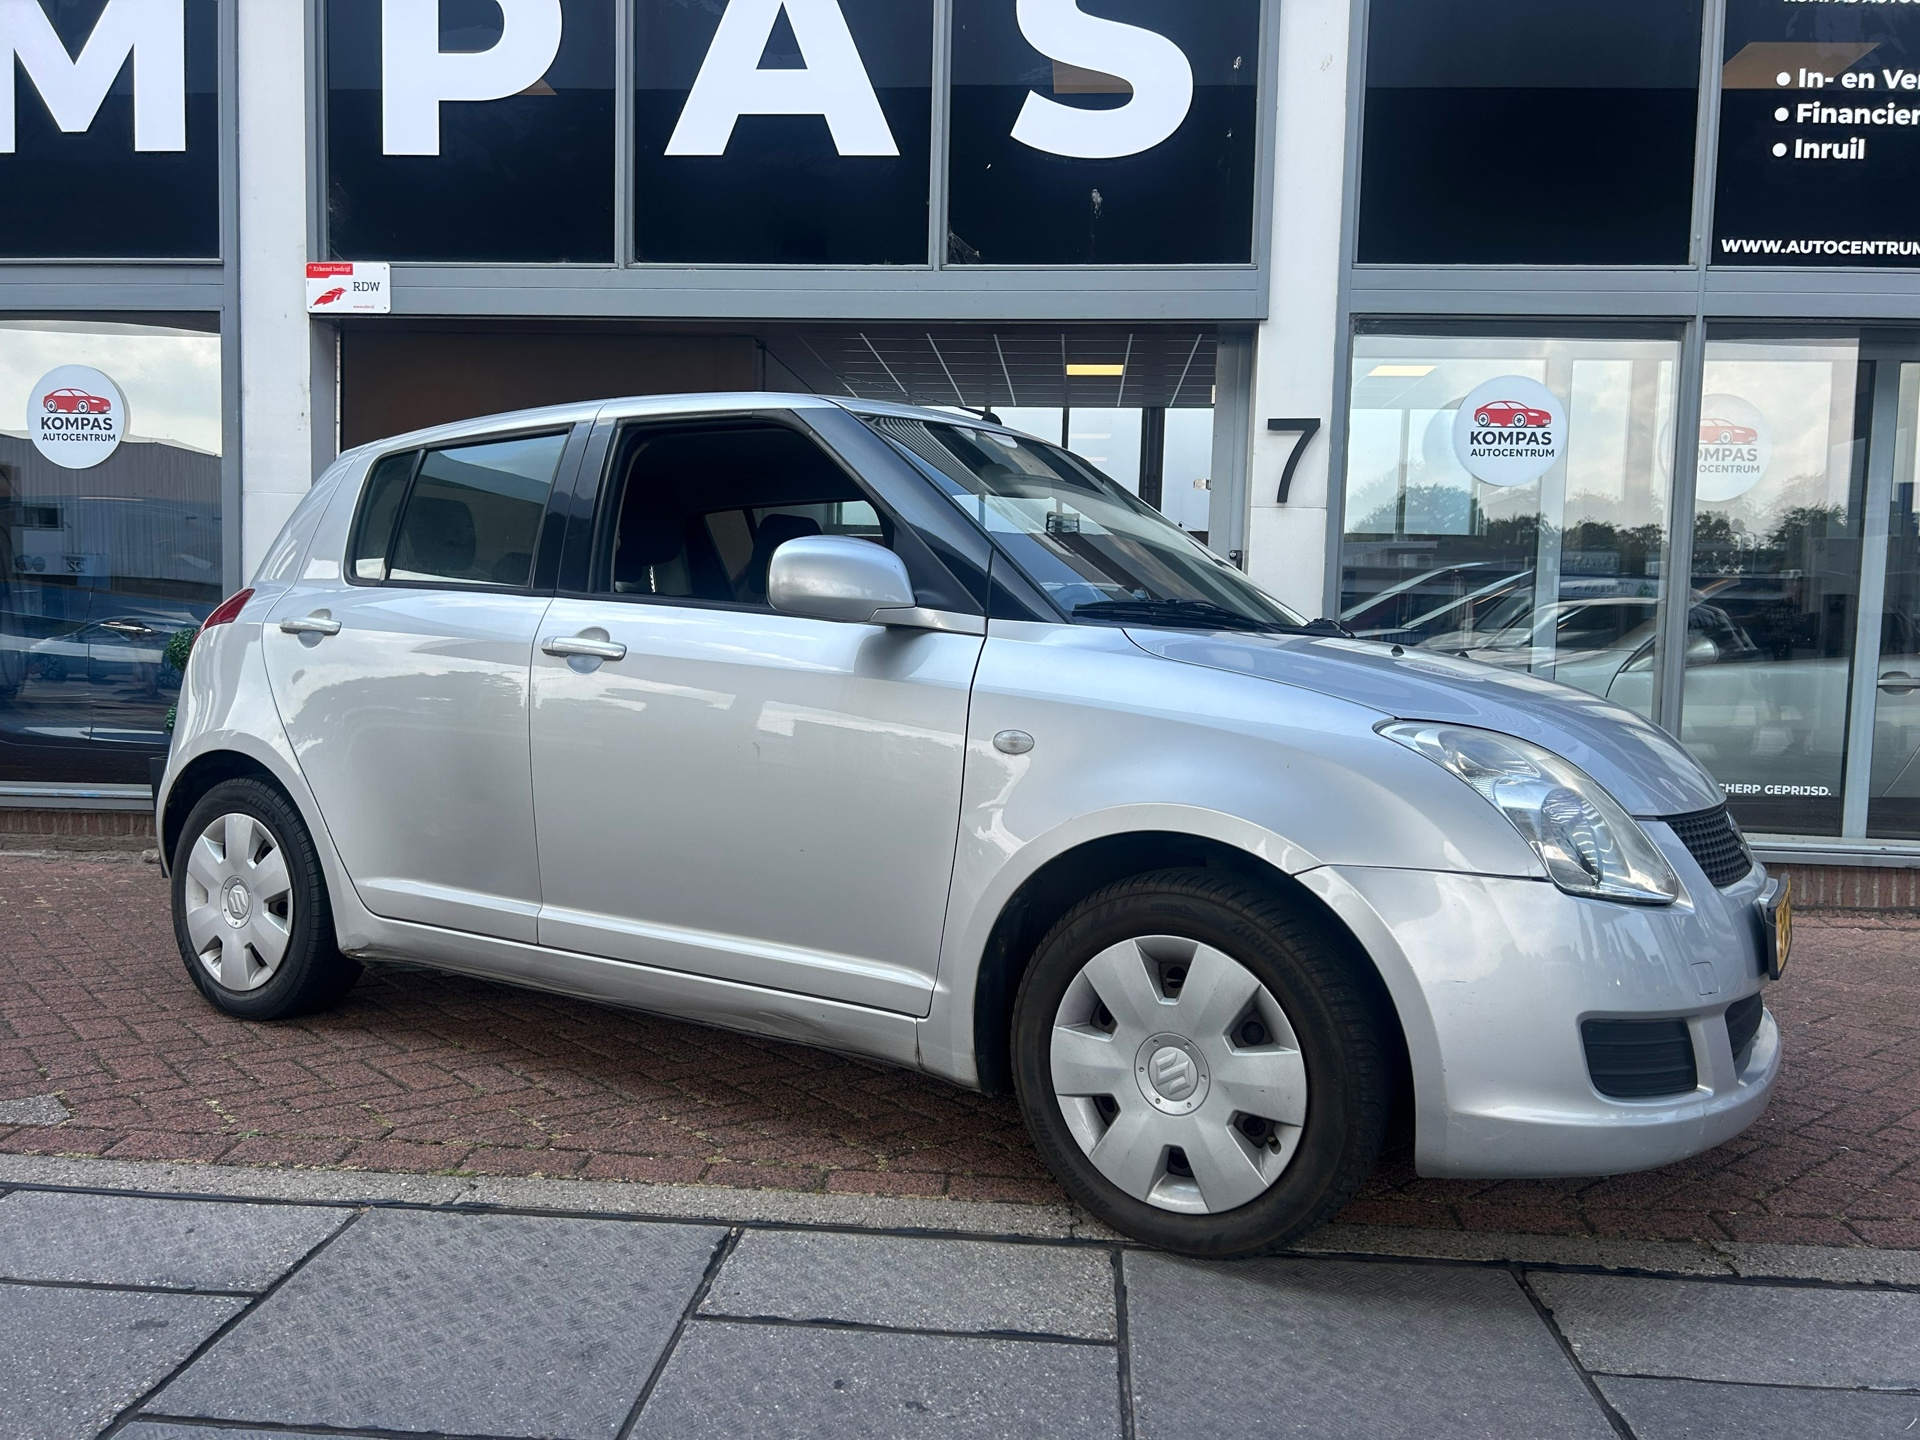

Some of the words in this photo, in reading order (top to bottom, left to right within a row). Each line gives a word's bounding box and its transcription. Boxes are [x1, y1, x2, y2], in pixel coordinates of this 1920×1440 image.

[1798, 68, 1834, 88] In-
[1841, 72, 1875, 89] en
[1882, 69, 1920, 90] Ve
[1794, 137, 1866, 160] Inruil
[352, 281, 381, 292] RDW
[40, 416, 113, 430] KOMPAS
[42, 433, 116, 442] AUTOCENTRUM
[1469, 431, 1552, 446] KOMPAS
[1470, 448, 1555, 458] AUTOCENTRUM
[1698, 447, 1758, 462] MPAS
[1267, 417, 1322, 504] 7
[1698, 464, 1760, 474] OCENTRUM
[1764, 784, 1832, 796] GEPRIJSD.
[1030, 1106, 1113, 1212] BRIDGESTONE
